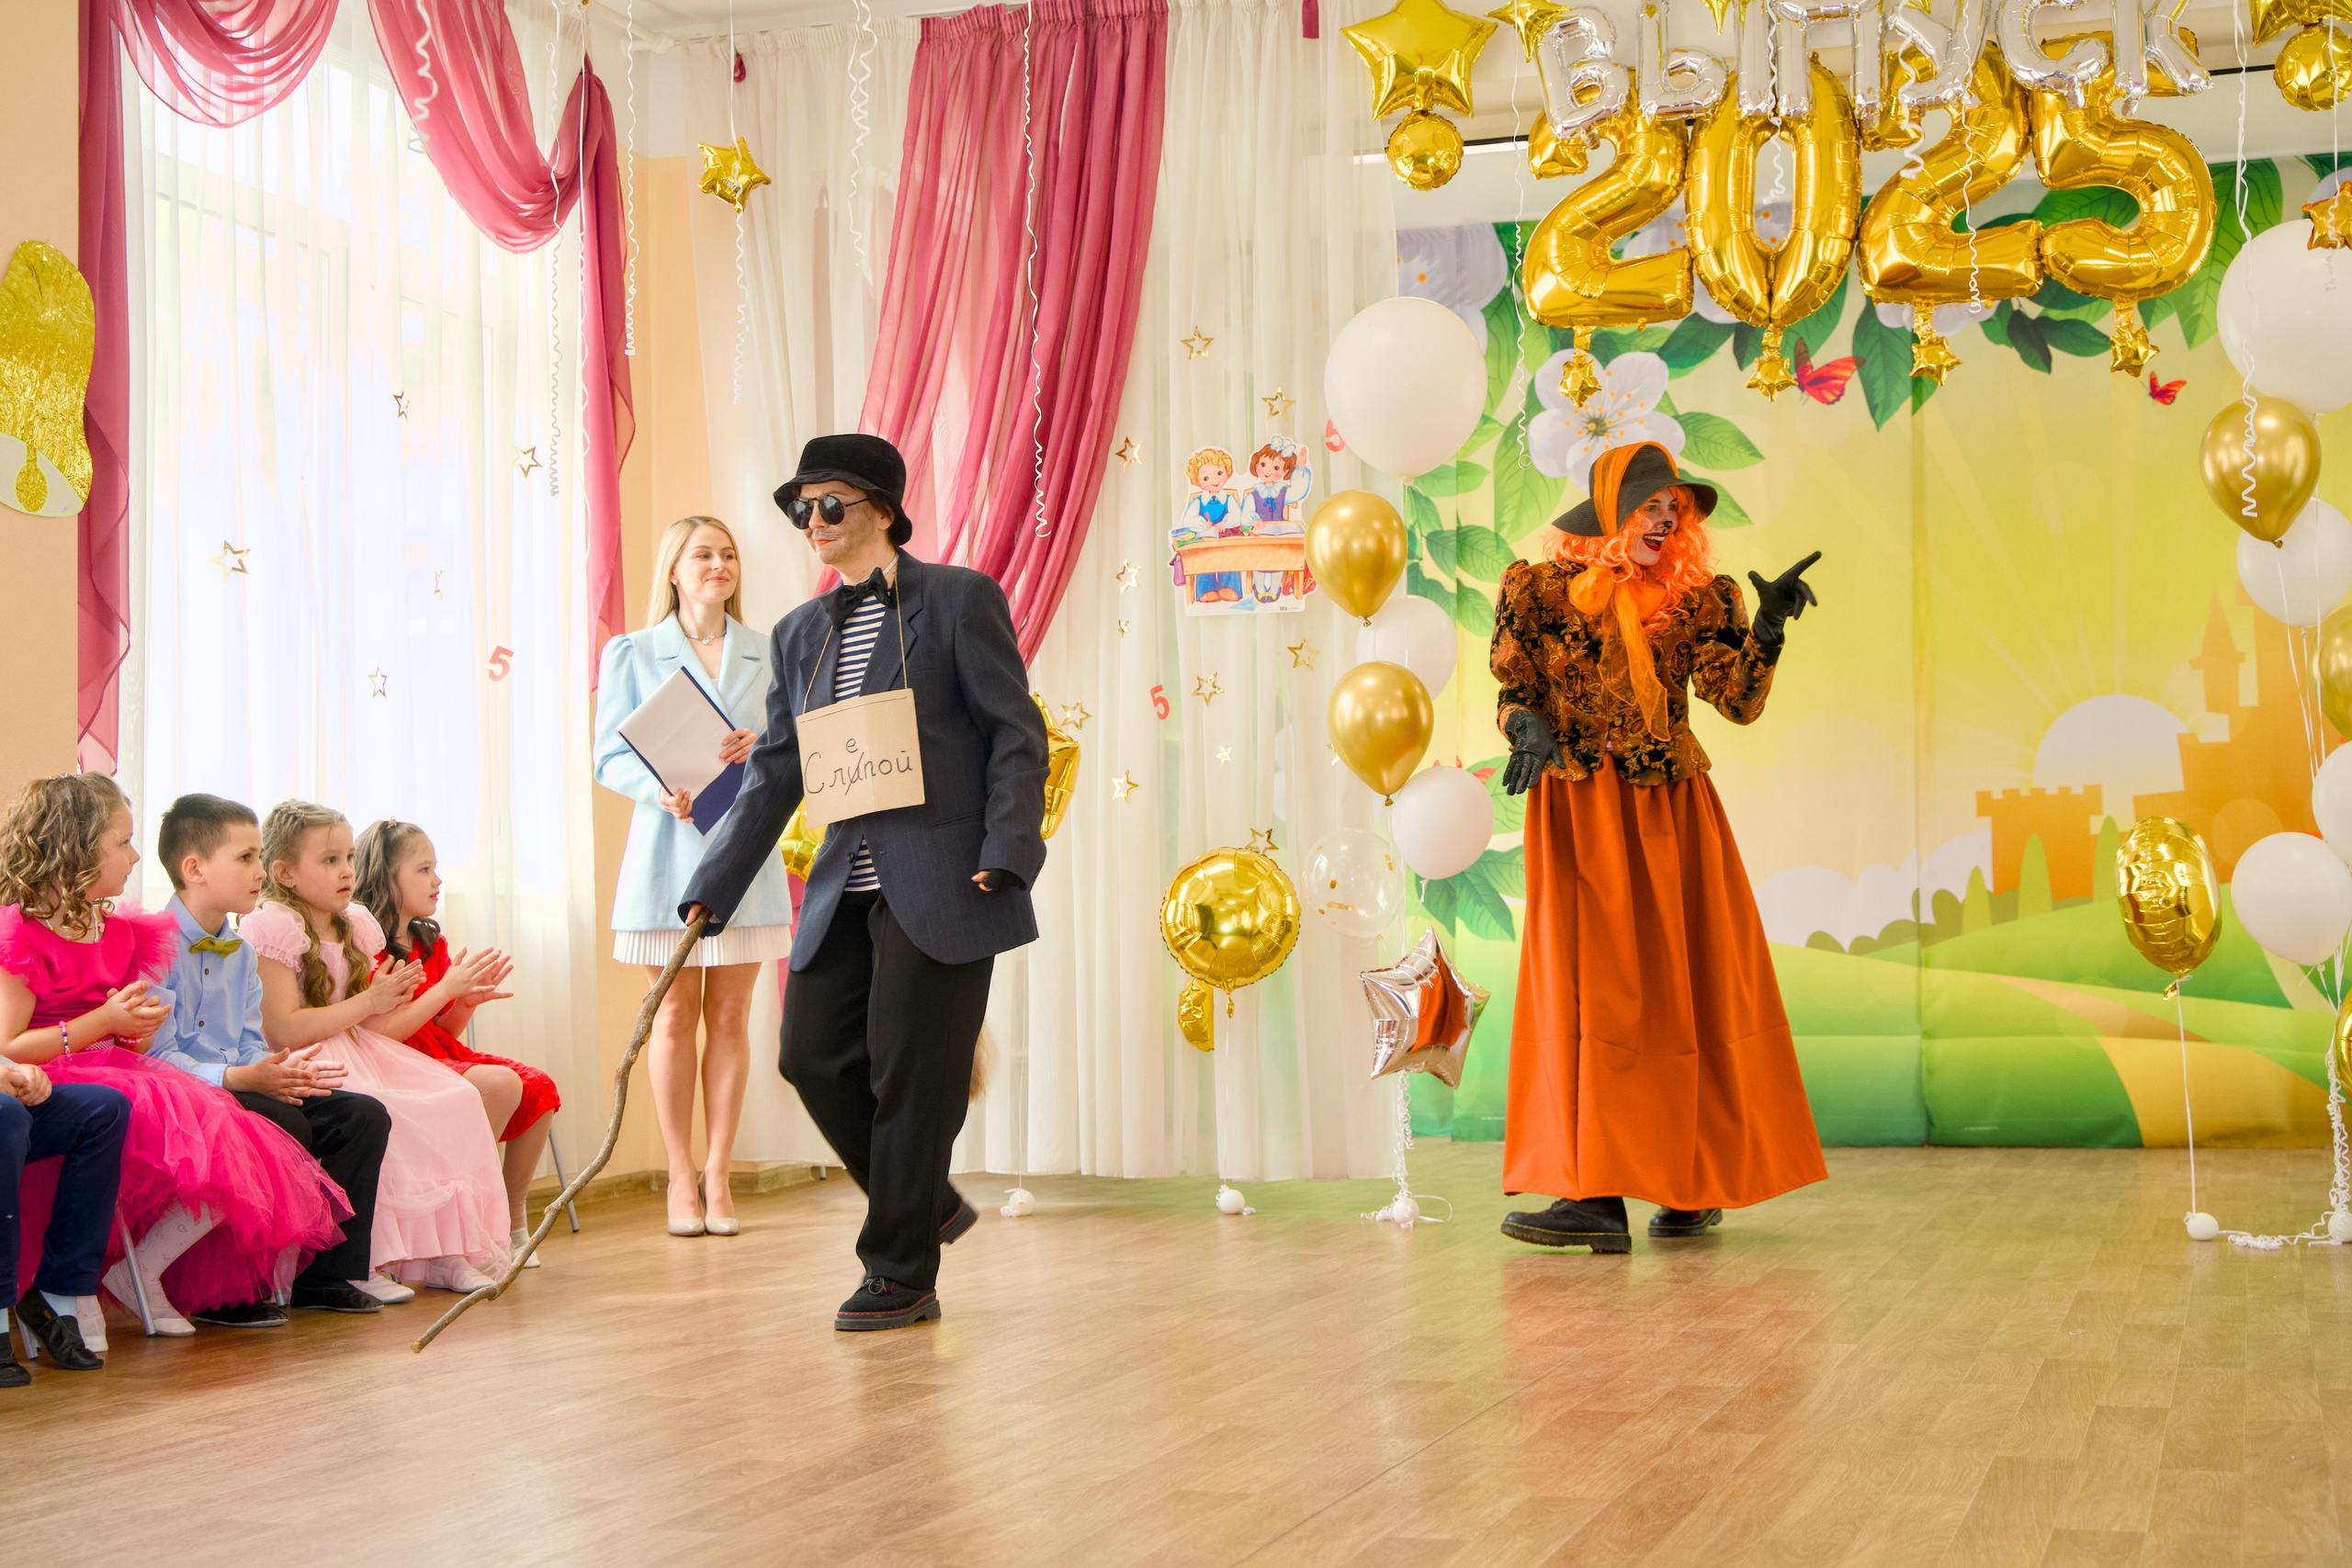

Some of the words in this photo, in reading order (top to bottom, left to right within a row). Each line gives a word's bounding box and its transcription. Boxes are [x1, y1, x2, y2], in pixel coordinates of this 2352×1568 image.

[1522, 37, 2215, 328] 2025
[489, 645, 514, 682] 5
[1149, 683, 1170, 720] 5
